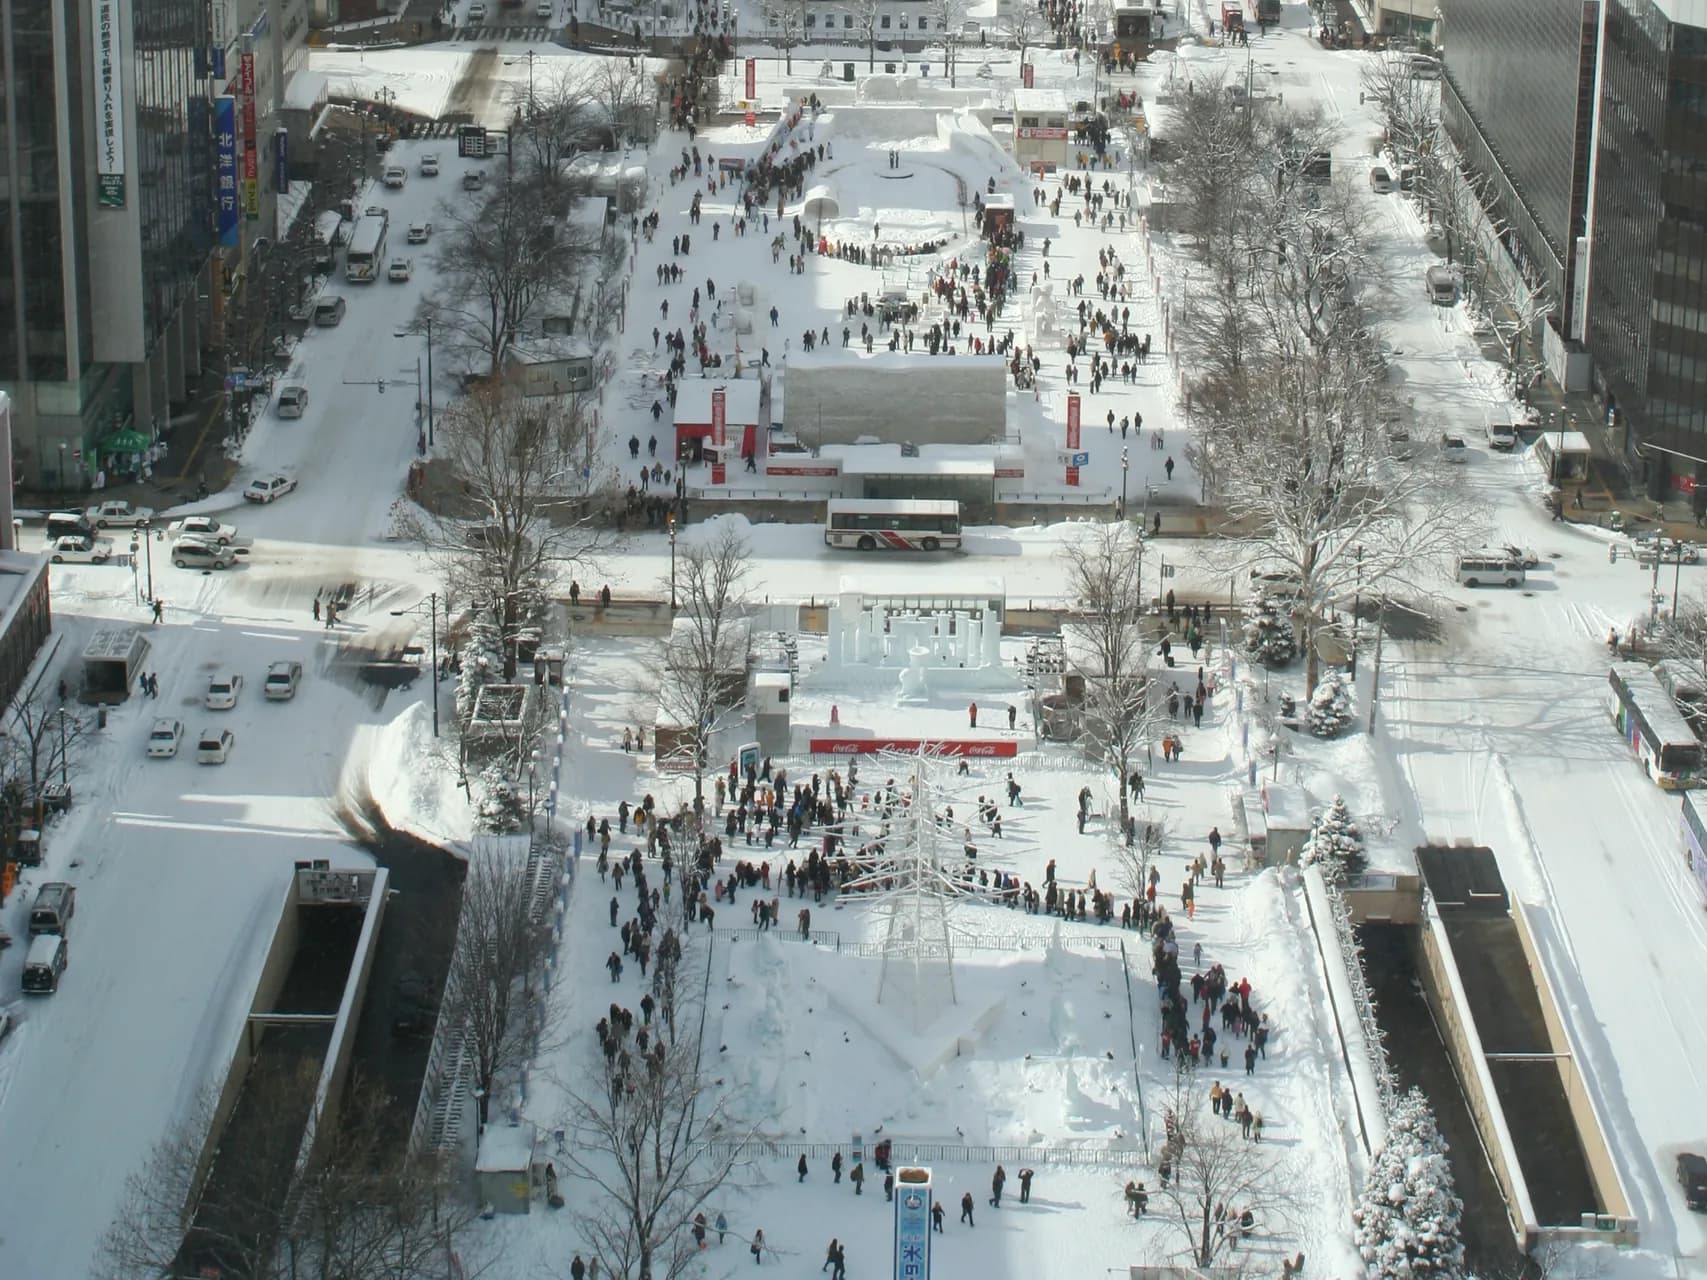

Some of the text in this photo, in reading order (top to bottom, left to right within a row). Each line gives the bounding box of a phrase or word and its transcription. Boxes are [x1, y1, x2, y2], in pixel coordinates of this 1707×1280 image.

[219, 132, 234, 211] 北洋銀行
[903, 1245, 922, 1280] 氷の
